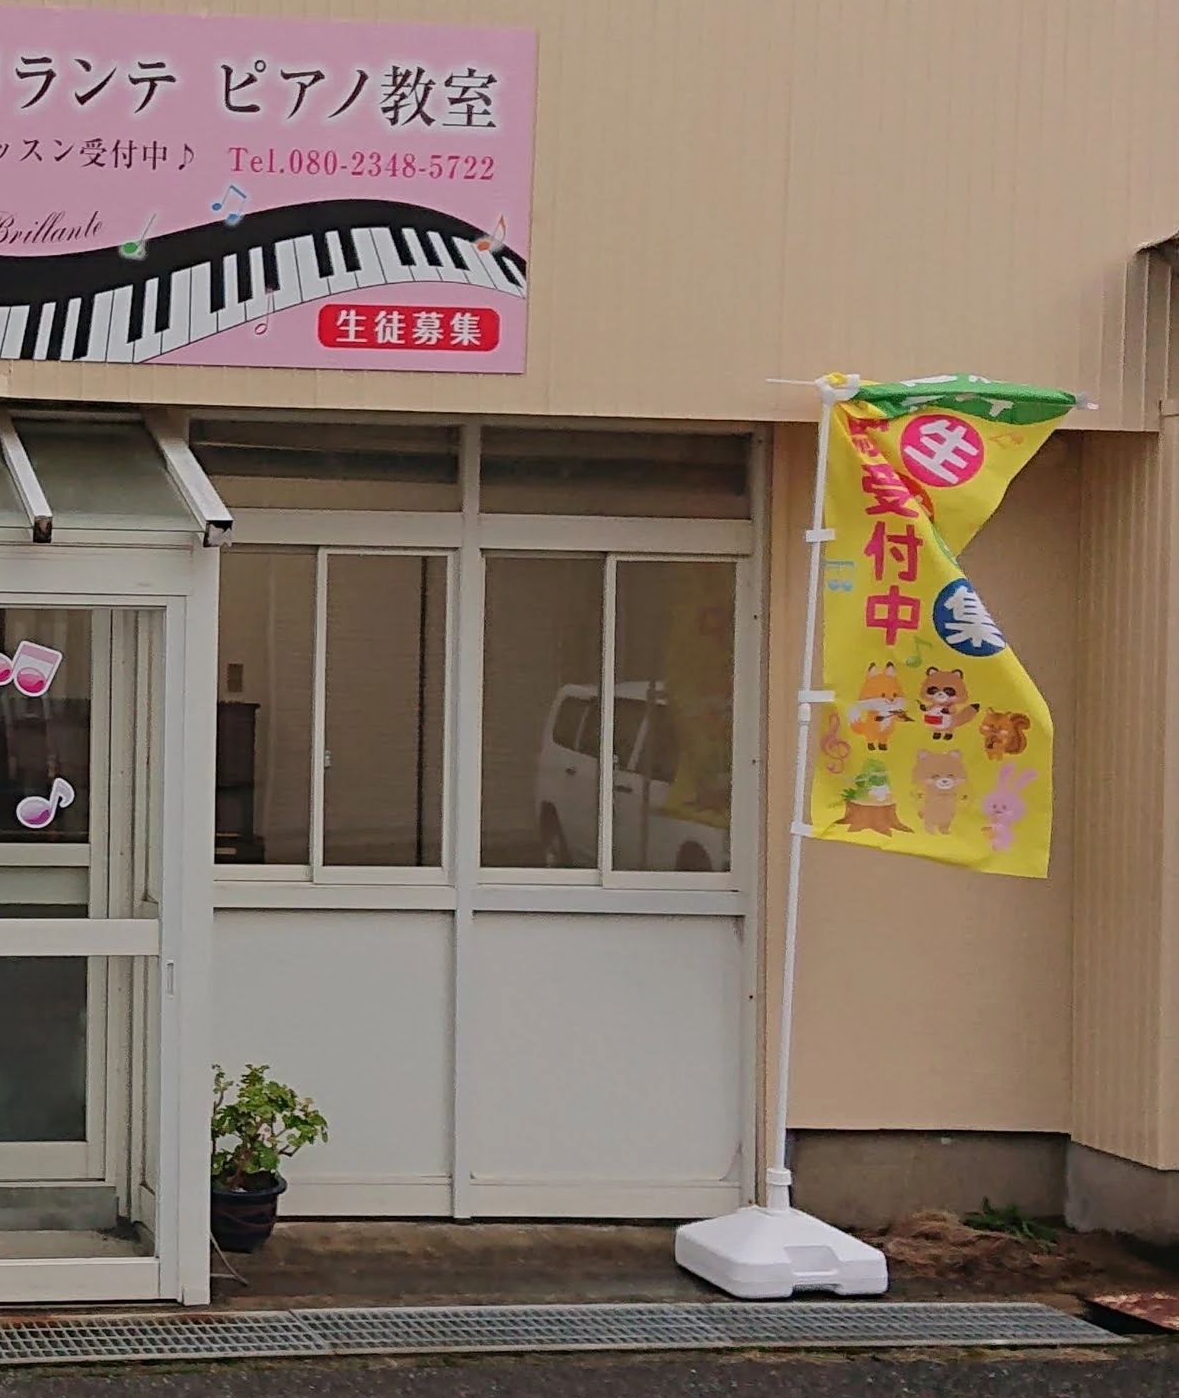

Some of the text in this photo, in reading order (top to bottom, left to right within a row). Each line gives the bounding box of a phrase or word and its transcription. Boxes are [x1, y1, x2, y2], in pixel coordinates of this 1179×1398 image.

[221, 60, 497, 128] ピアノ教室
[229, 147, 495, 180] Tel.080-2348-5722
[336, 310, 482, 346] 生徒募集
